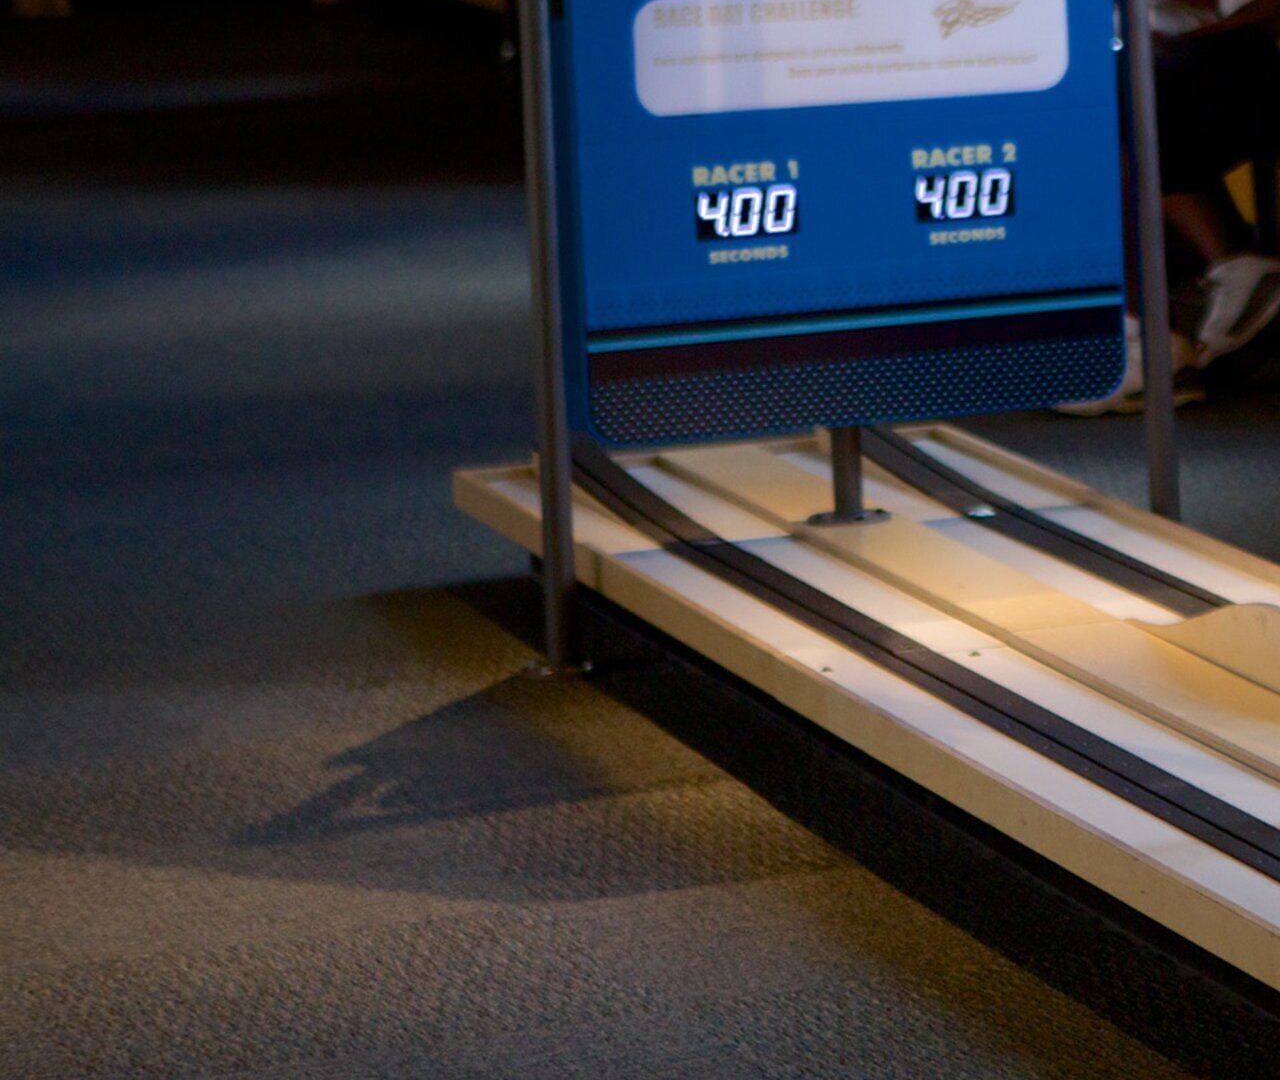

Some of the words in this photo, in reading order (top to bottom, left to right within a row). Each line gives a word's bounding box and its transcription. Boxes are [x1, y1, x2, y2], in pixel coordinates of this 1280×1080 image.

[911, 145, 993, 169] RACER
[1002, 142, 1018, 163] 2
[692, 162, 776, 187] RACER
[788, 160, 799, 180] 1
[929, 226, 1006, 246] SECONDS
[709, 244, 789, 265] SECONDS
